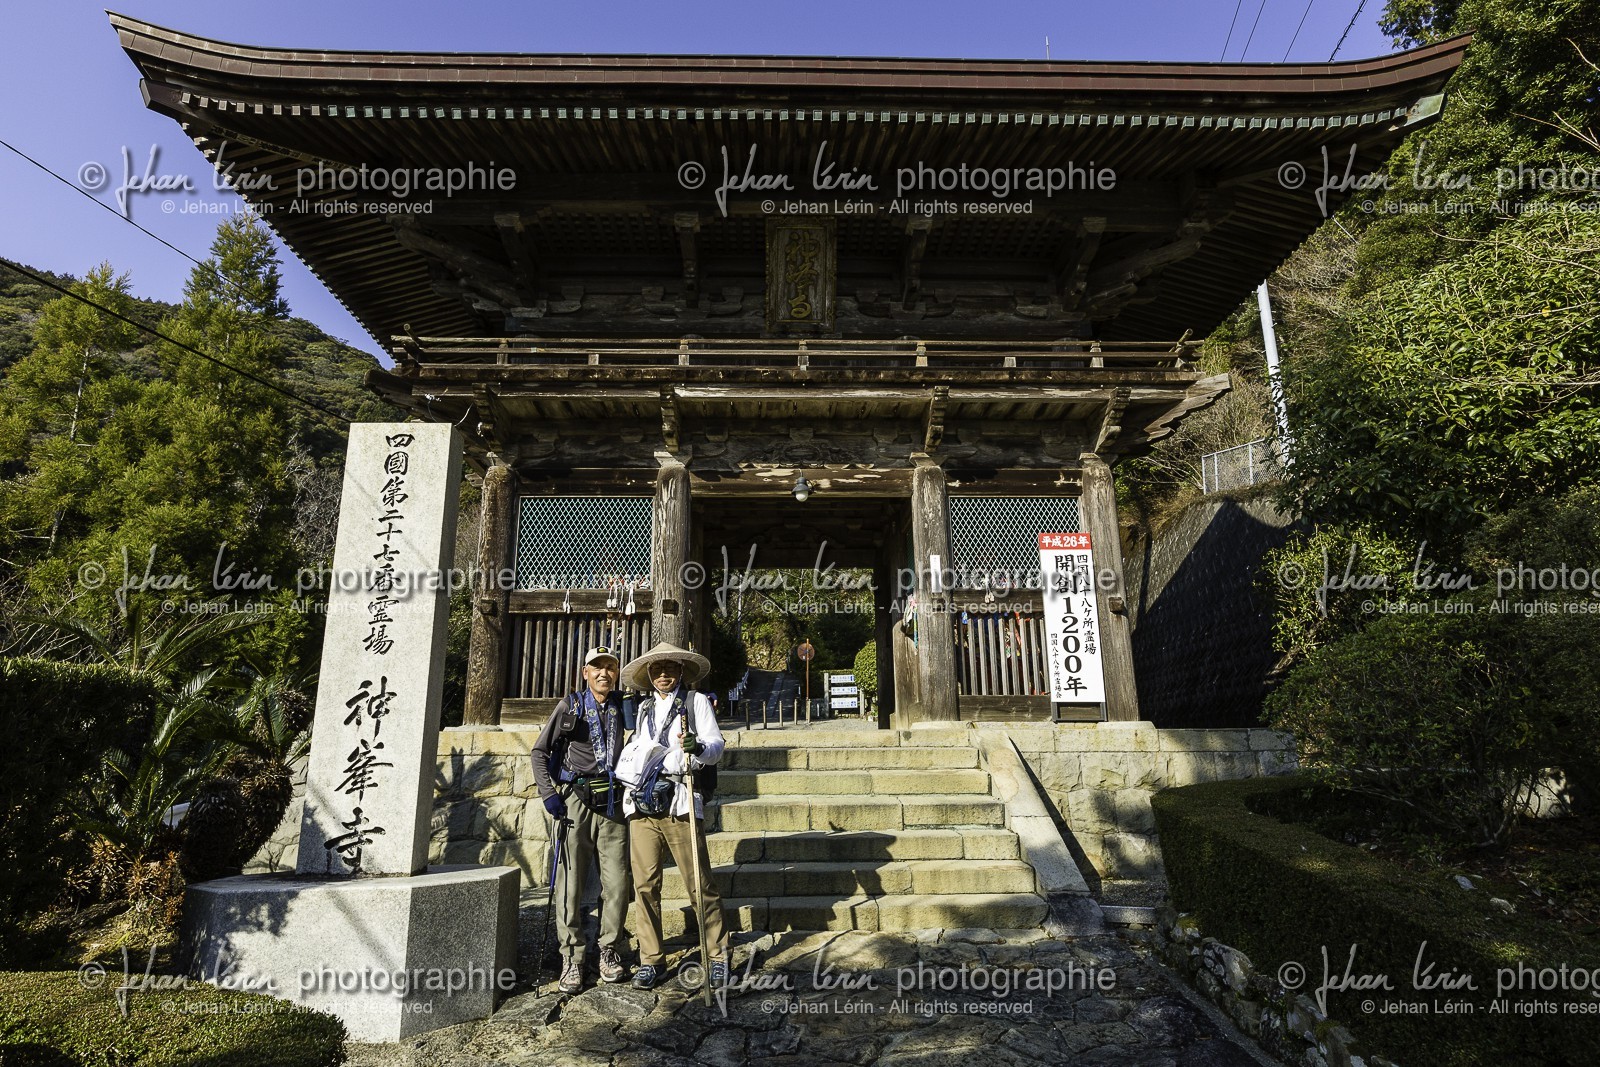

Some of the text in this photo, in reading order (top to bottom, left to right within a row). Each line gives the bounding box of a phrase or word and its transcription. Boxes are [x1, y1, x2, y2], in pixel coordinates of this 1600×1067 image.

[1041, 535, 1089, 548] 平成26年
[1054, 553, 1088, 697] 開創1200年
[324, 675, 398, 873] 神峯寺
